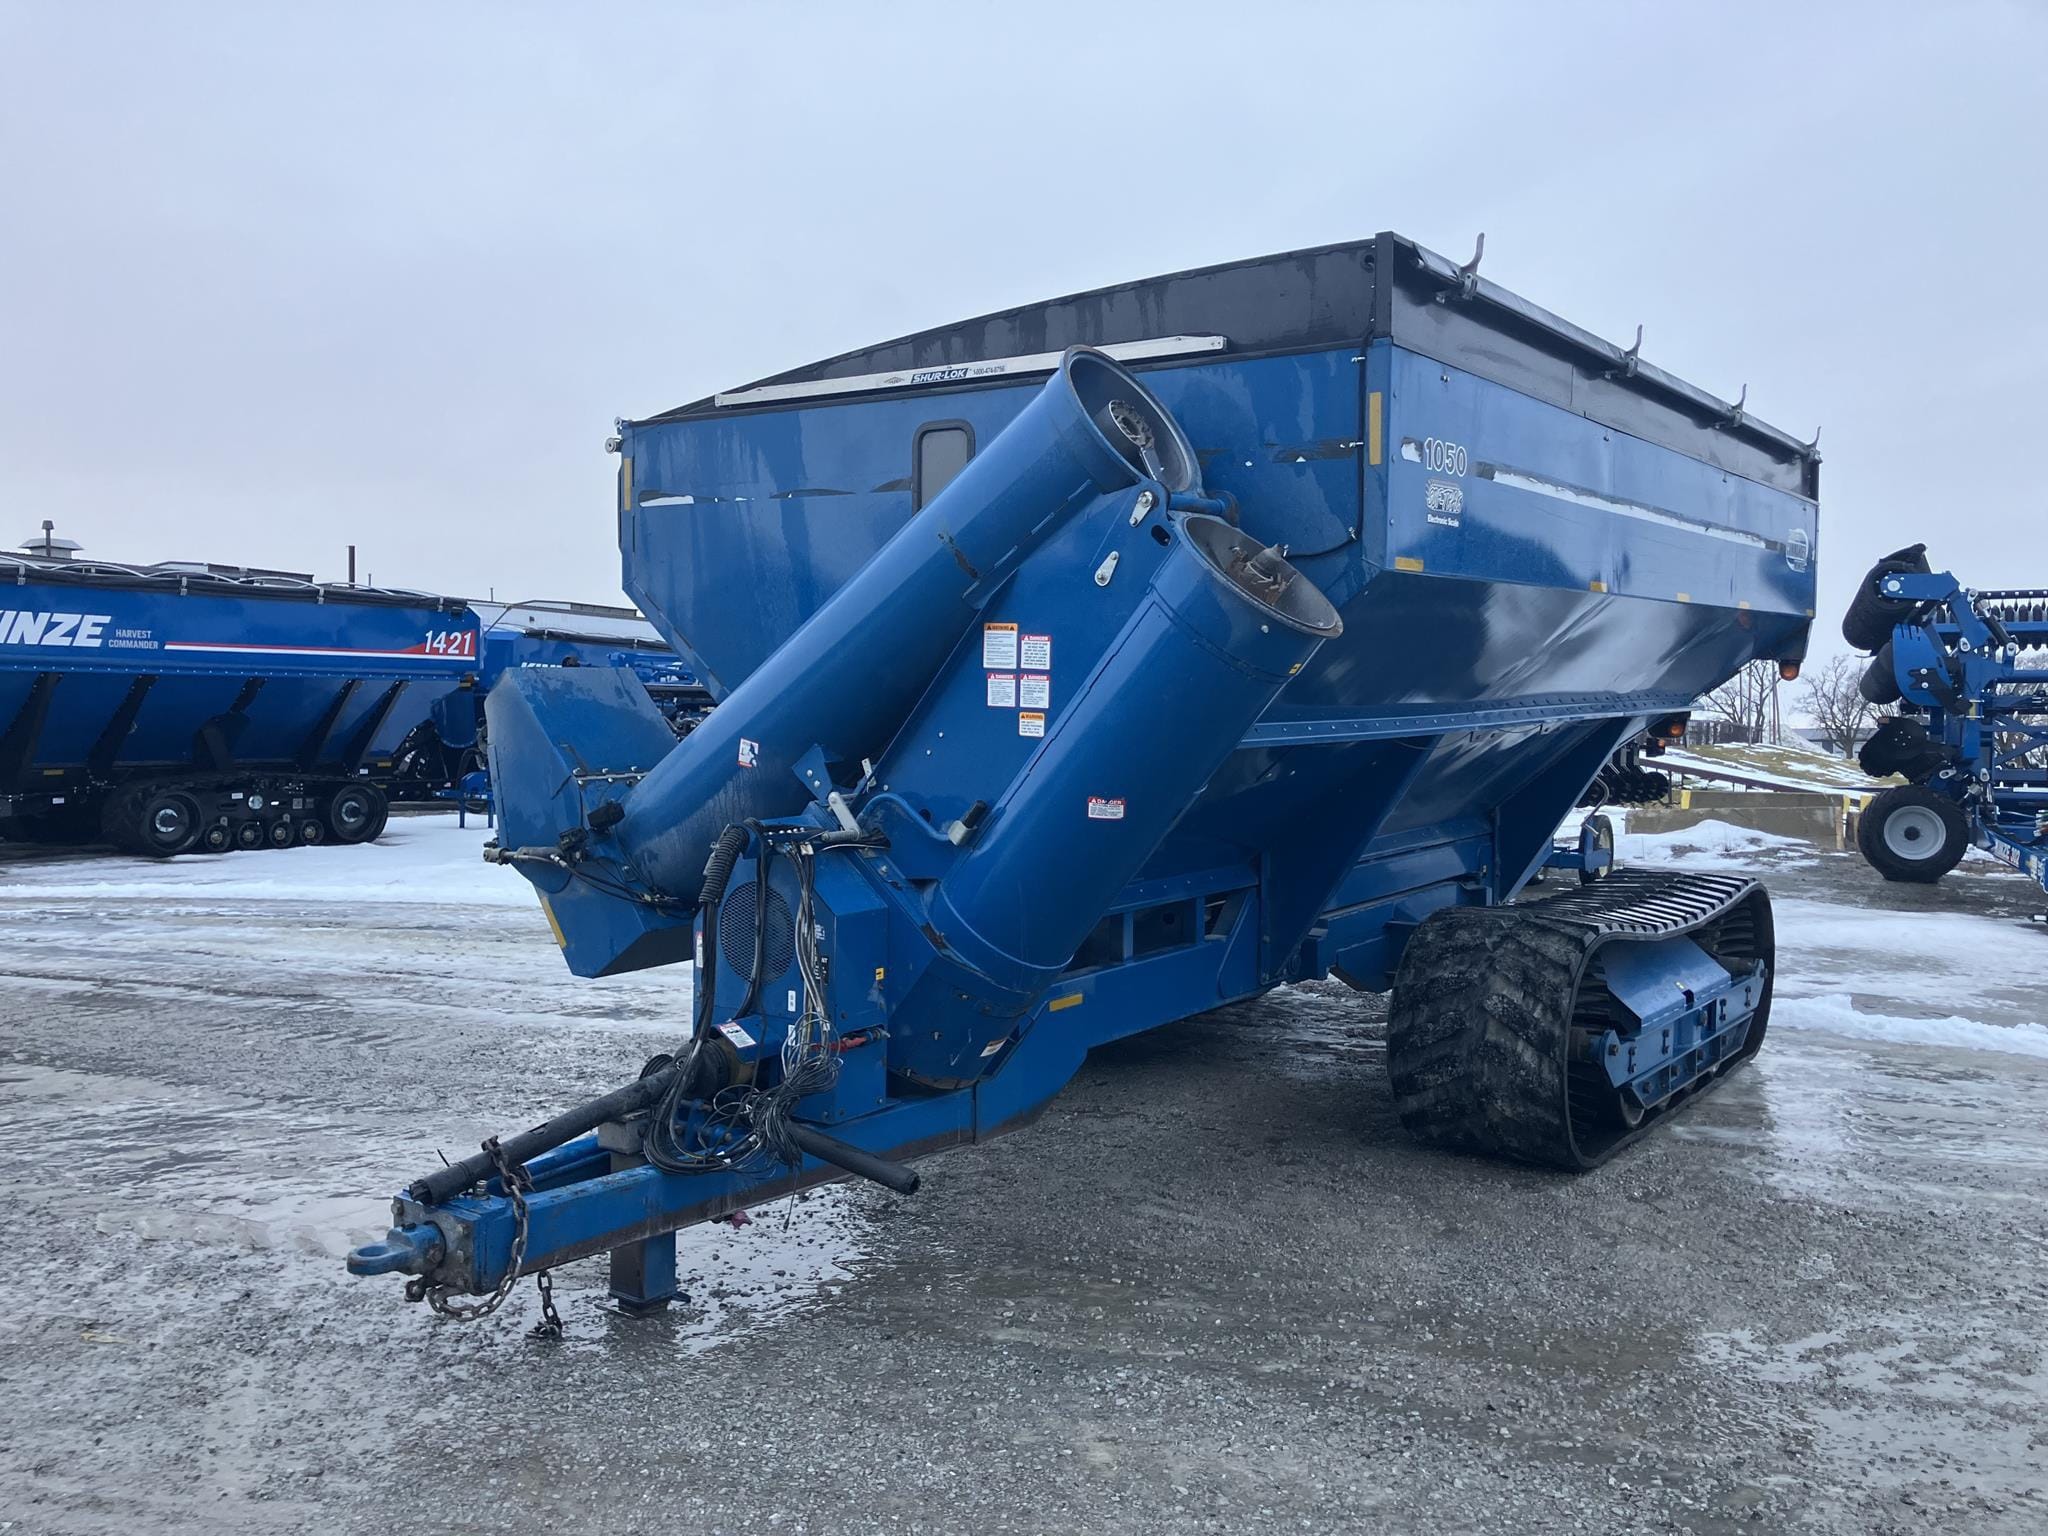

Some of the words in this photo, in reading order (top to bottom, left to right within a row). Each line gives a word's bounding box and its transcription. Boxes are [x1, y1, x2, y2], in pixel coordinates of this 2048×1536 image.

[1424, 437, 1467, 477] 1050
[0, 610, 112, 647] INZE
[115, 628, 152, 639] HARVEST
[108, 639, 159, 650] COMMANDER
[425, 630, 472, 655] 1421
